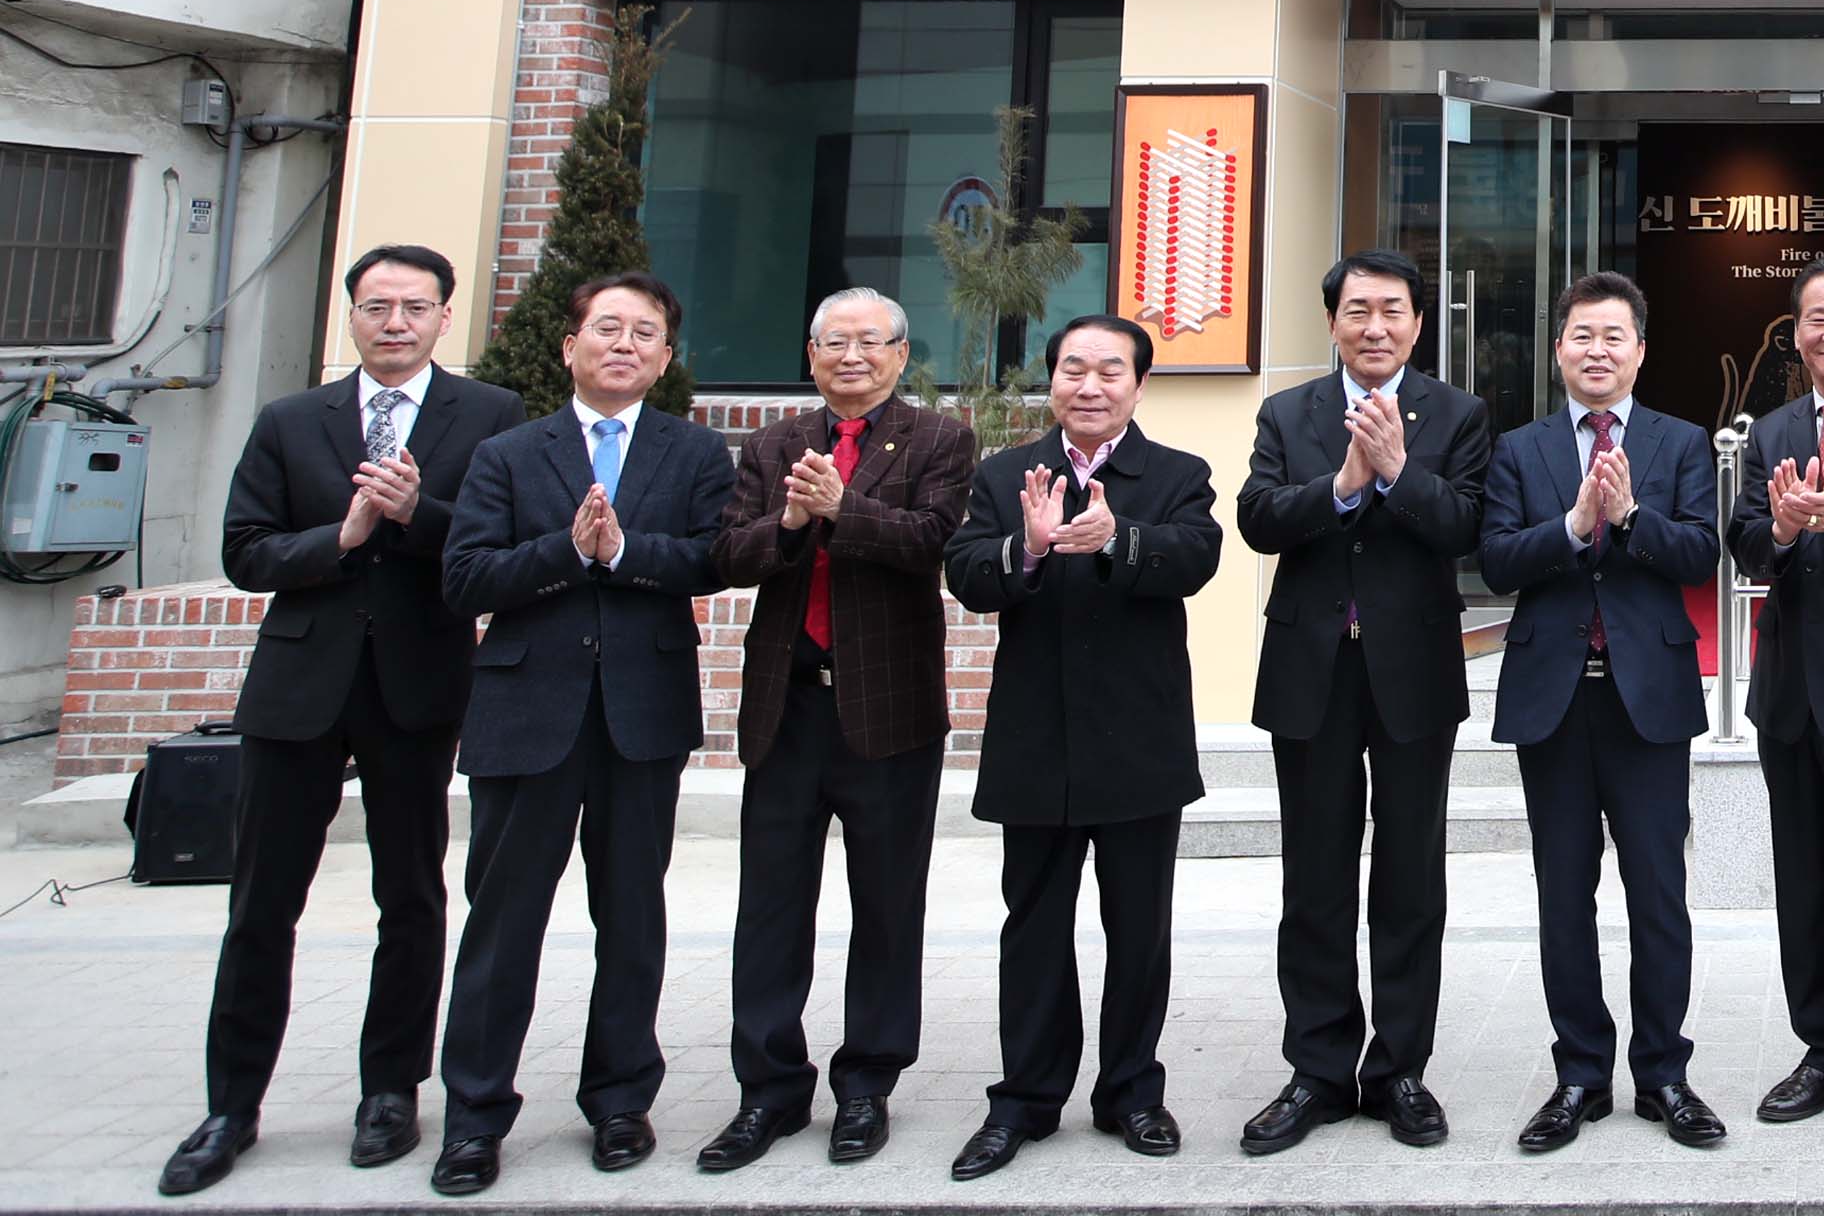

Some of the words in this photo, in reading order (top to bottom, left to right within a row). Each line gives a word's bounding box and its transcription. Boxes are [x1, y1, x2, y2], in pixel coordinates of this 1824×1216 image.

[1638, 195, 1676, 232] 신
[1780, 248, 1812, 261] Fire
[1731, 265, 1762, 278] The
